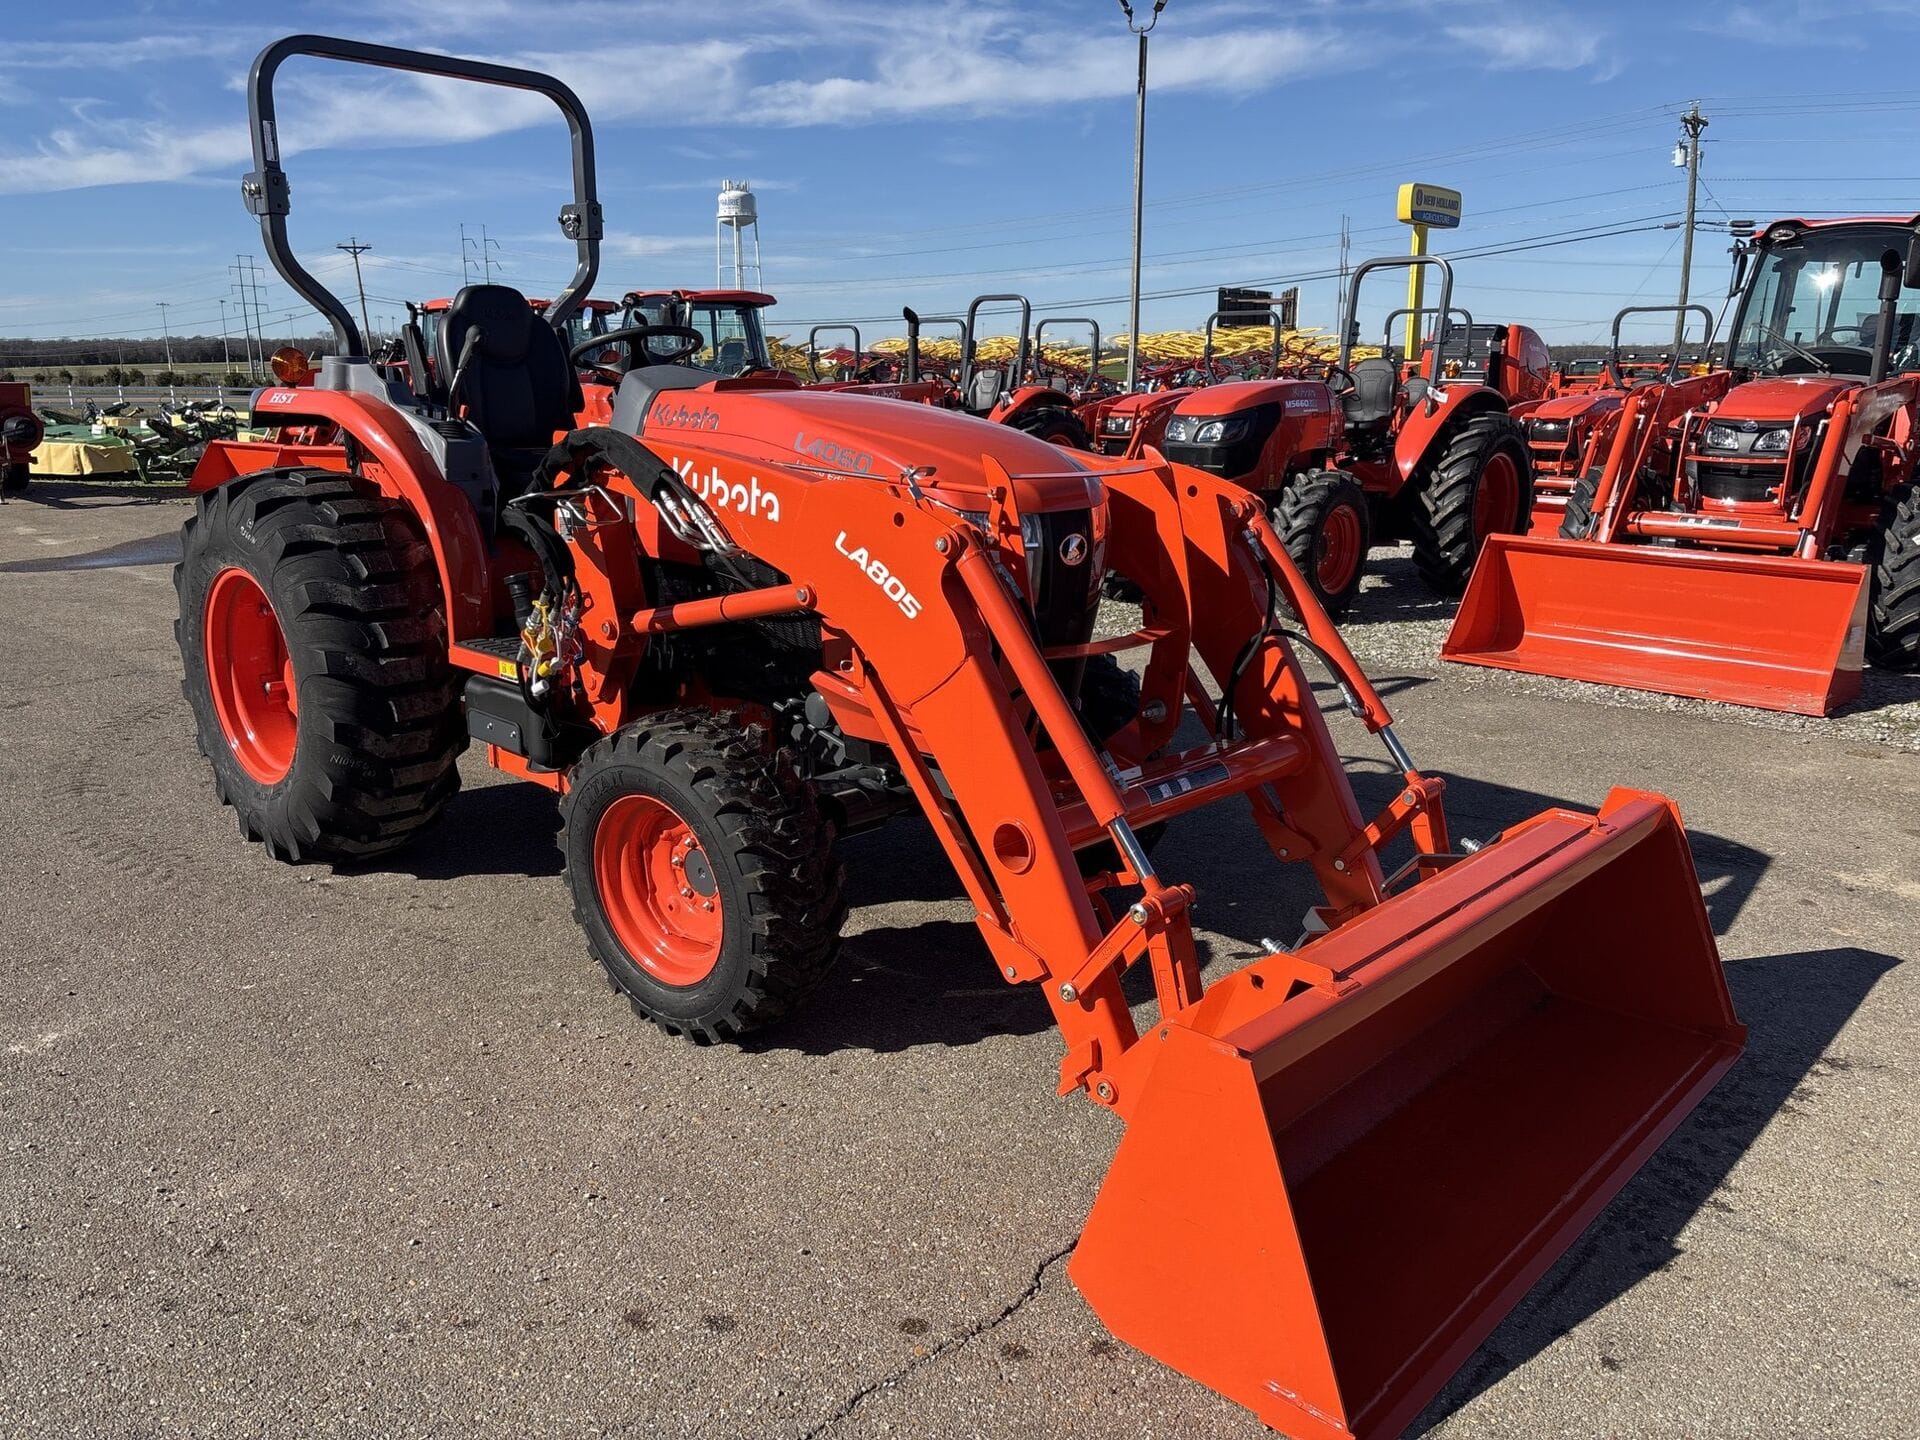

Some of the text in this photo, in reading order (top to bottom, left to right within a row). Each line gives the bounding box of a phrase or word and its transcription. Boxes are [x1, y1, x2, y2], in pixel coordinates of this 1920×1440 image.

[1423, 194, 1459, 211] NEW HOLLAND
[269, 392, 299, 404] HST
[653, 403, 720, 430] Kubota
[793, 431, 874, 473] L4060
[672, 456, 780, 523] Kubota
[834, 529, 924, 620] LA805
